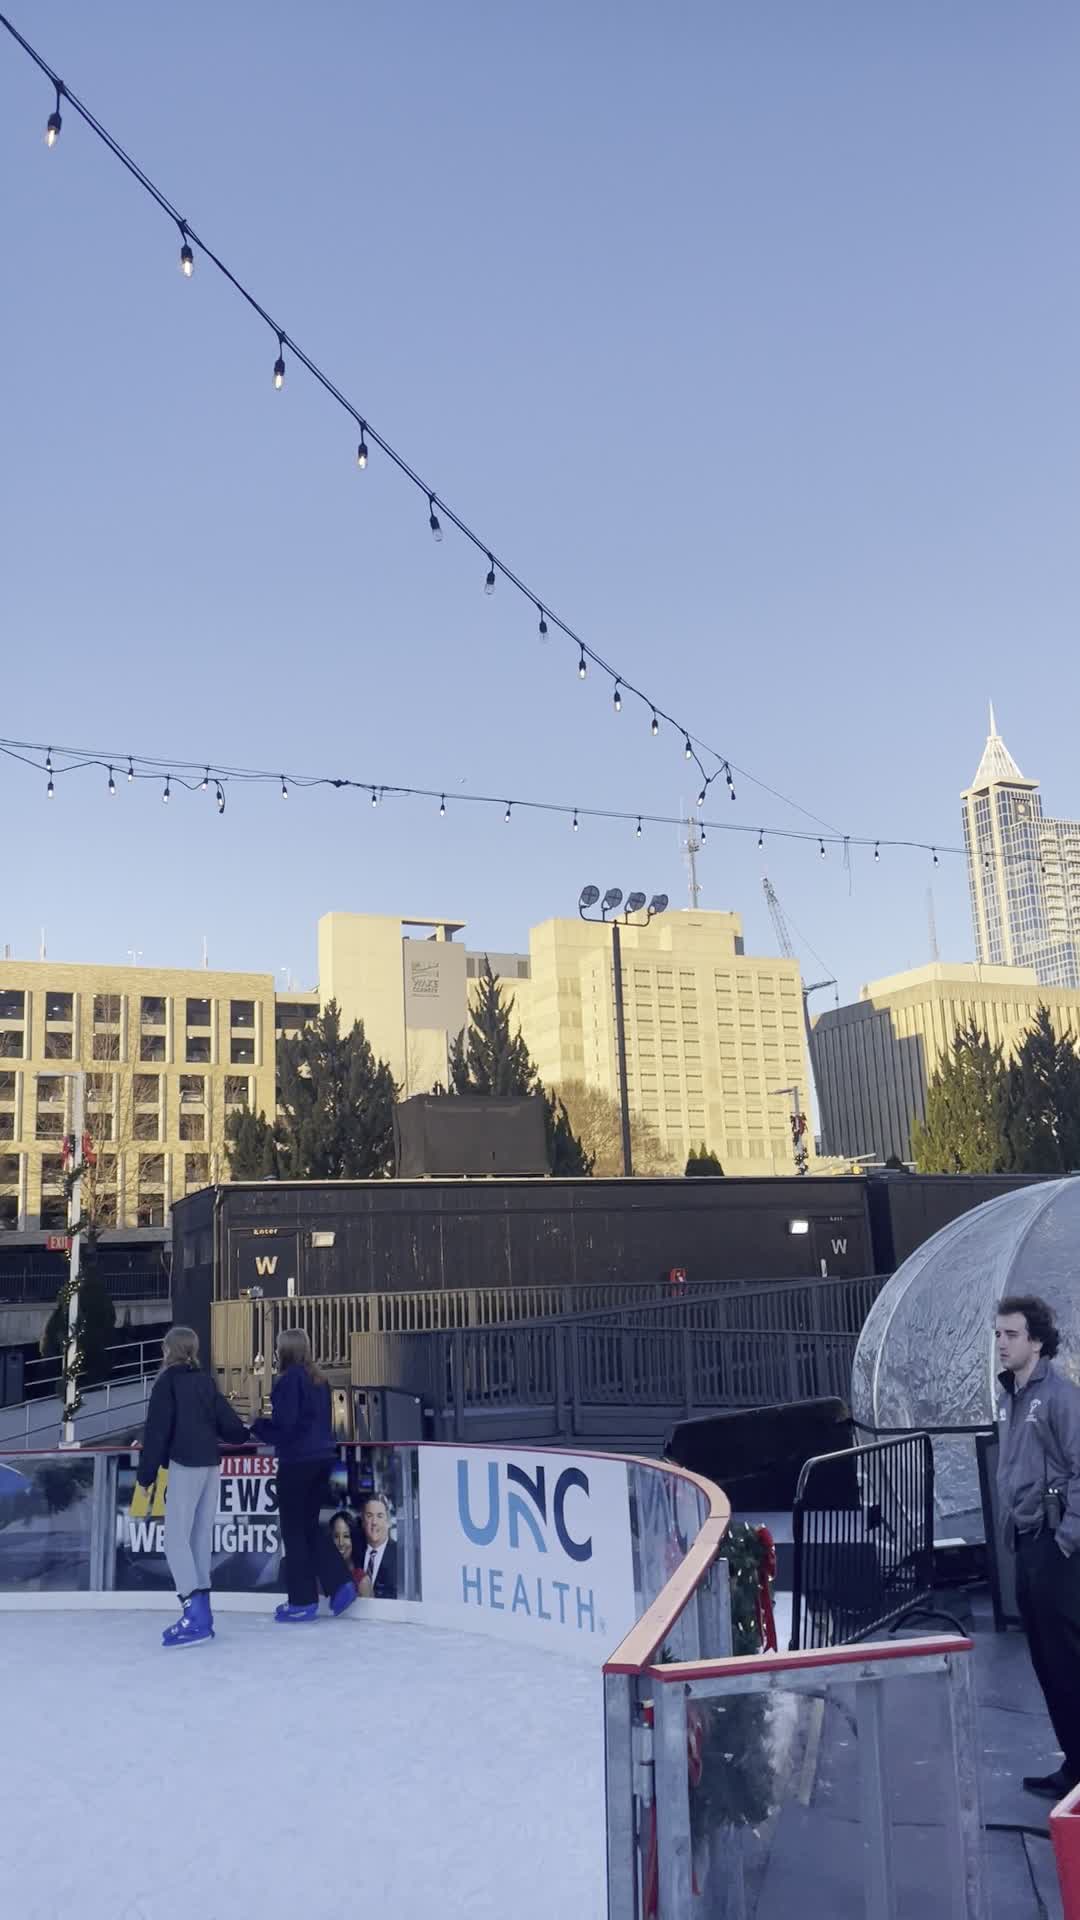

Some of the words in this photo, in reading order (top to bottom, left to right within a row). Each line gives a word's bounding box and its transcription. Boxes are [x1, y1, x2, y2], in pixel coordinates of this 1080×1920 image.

[831, 1238, 847, 1255] W
[255, 1255, 278, 1275] W
[220, 1478, 279, 1513] EWS
[457, 1459, 593, 1562] UNC
[129, 1522, 278, 1553] WEIGHTS
[462, 1565, 595, 1633] HEALTH
